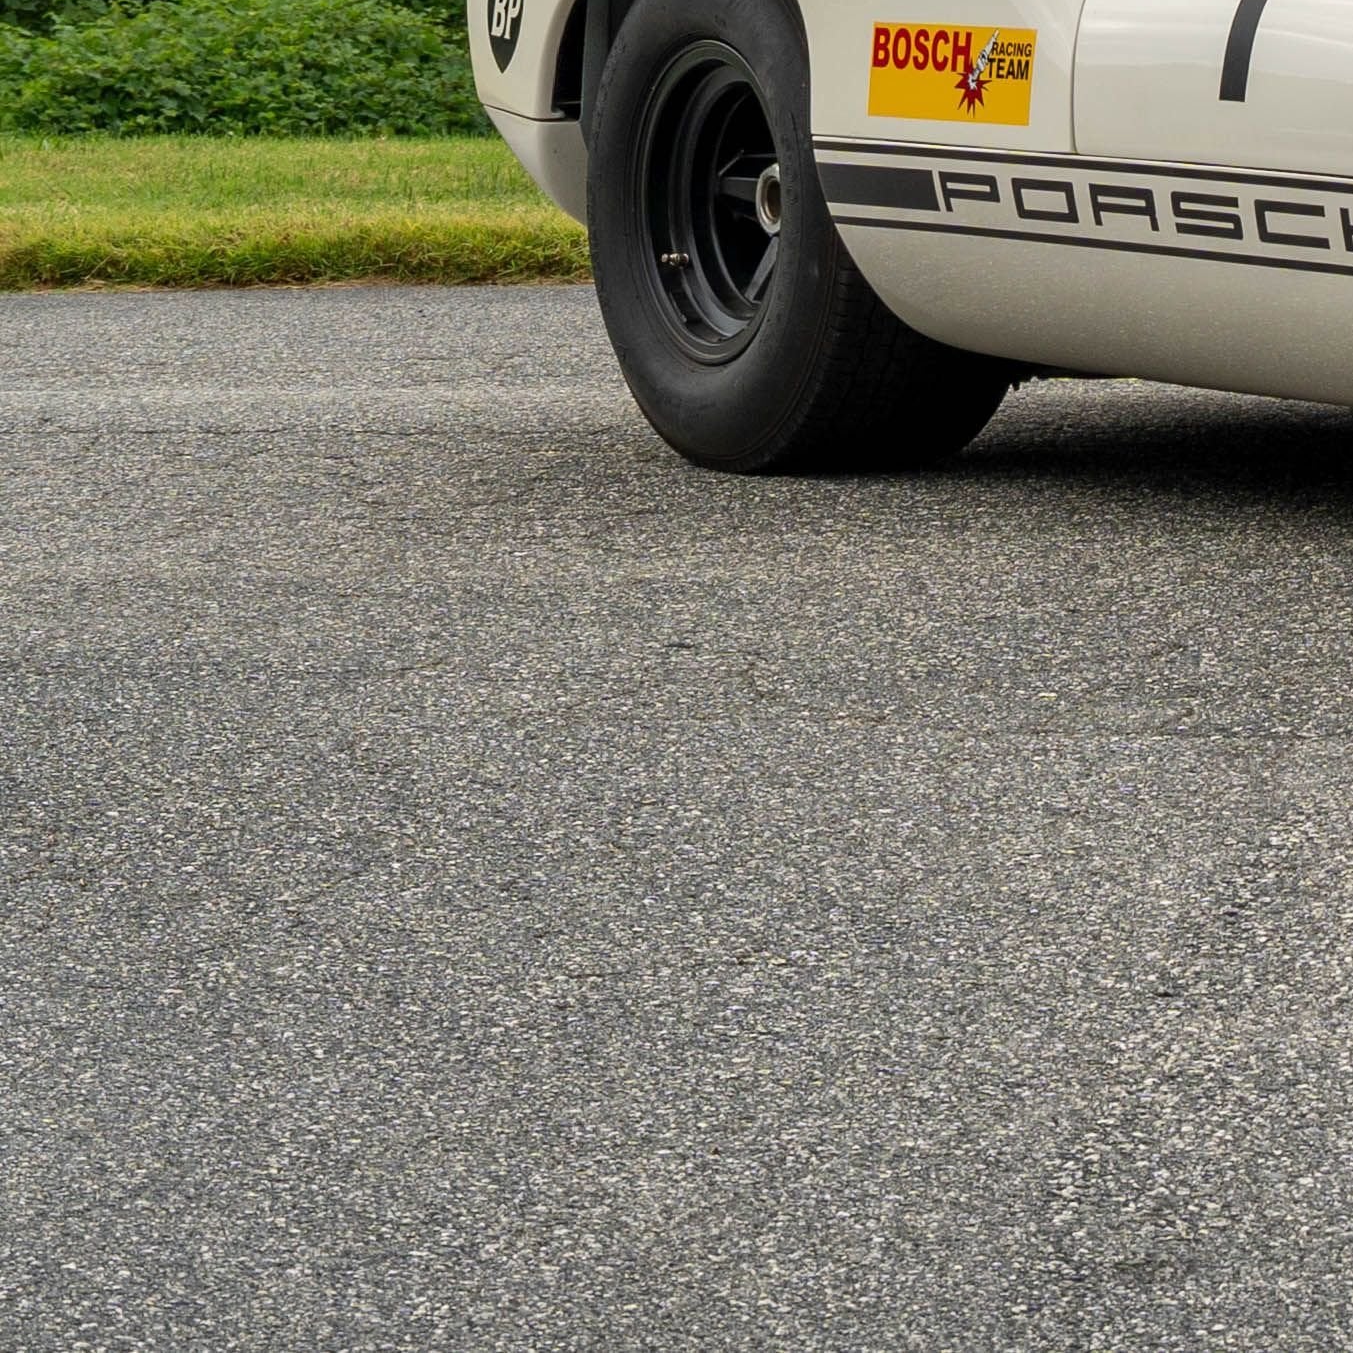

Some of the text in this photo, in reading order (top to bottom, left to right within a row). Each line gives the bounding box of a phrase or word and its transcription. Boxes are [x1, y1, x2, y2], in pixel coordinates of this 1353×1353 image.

[872, 27, 972, 73] BOSCH
[990, 41, 1032, 57] RACING
[987, 58, 1030, 80] TEAM
